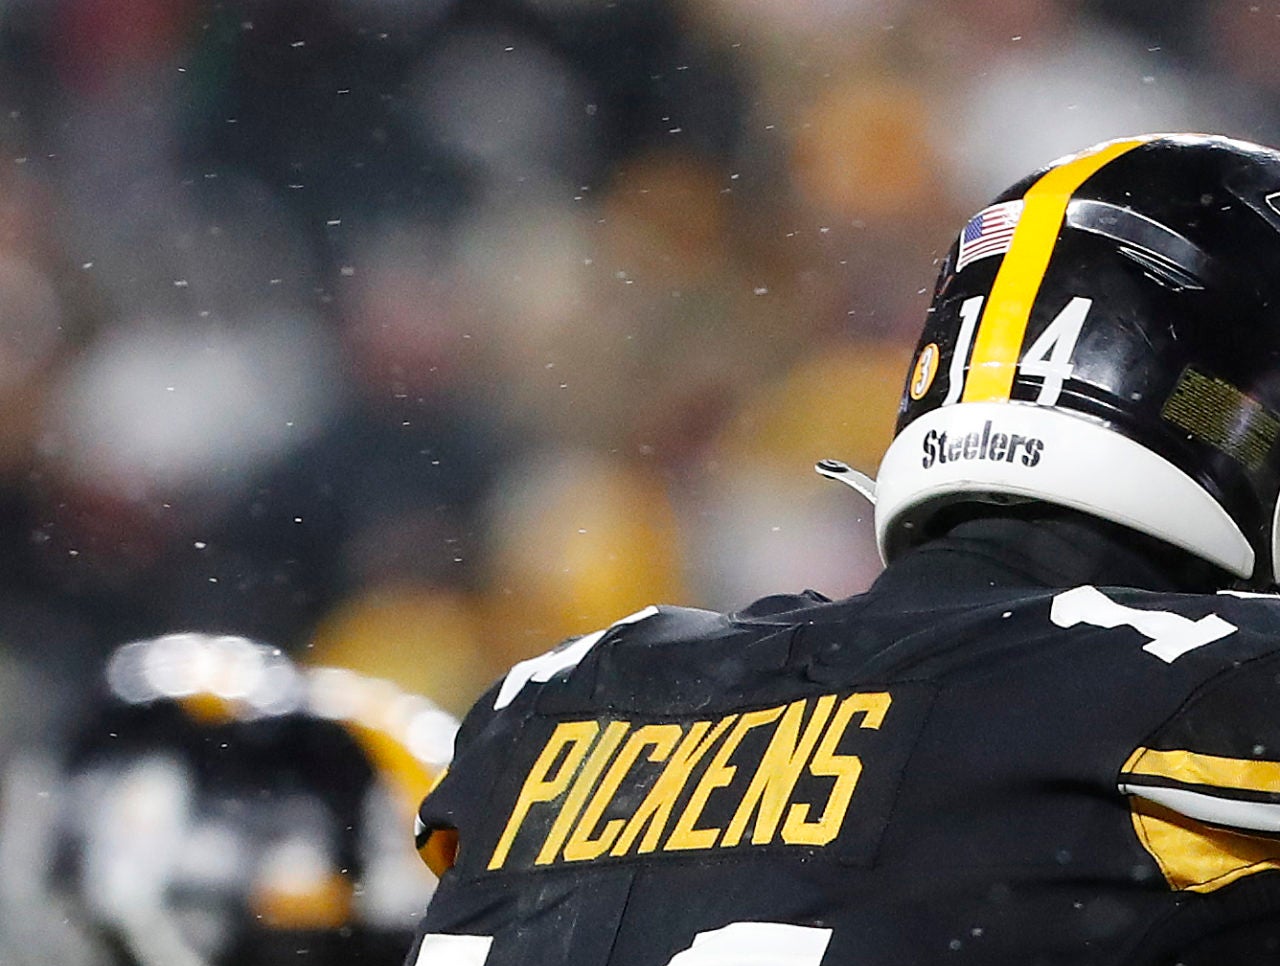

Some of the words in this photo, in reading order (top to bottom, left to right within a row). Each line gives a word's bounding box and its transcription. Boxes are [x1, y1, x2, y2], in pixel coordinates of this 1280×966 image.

[942, 295, 1093, 407] 14
[922, 420, 1045, 469] Steelers
[487, 690, 893, 871] PICKENS
